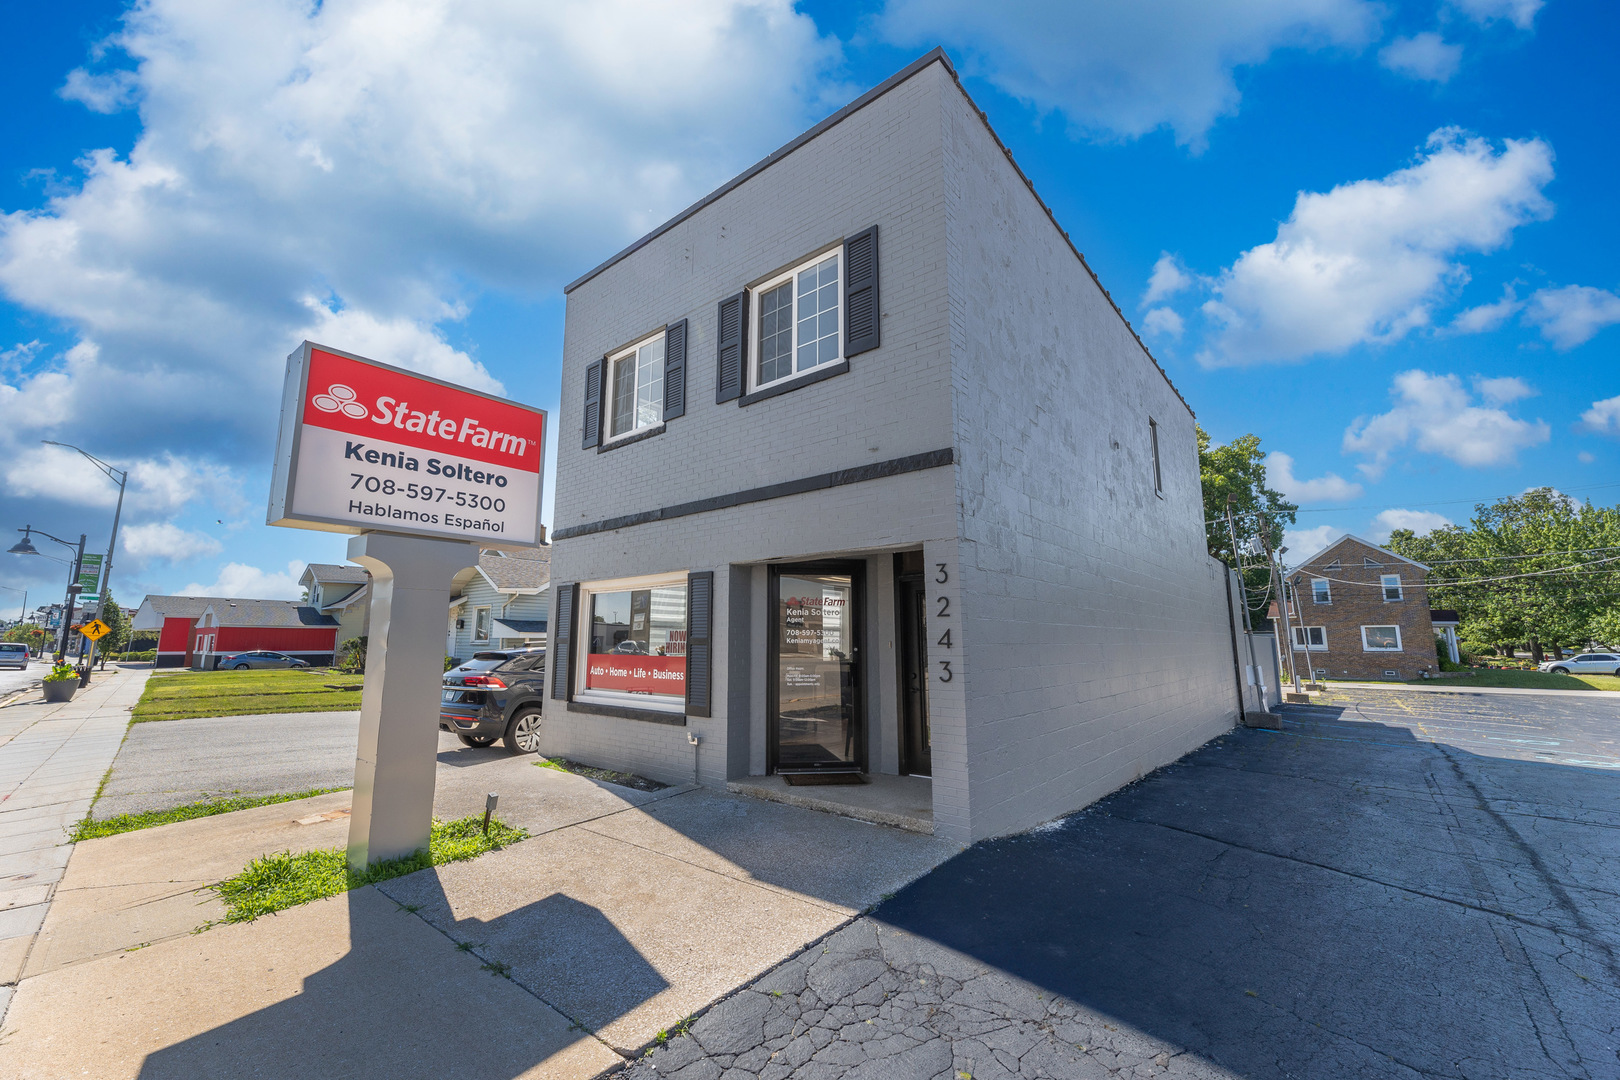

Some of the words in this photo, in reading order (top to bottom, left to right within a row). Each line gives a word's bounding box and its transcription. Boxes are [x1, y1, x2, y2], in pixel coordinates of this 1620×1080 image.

[344, 441, 419, 472] Kenia
[426, 458, 508, 488] Soltero
[350, 473, 506, 513] 708-597-5300
[348, 500, 439, 524] Hablamos
[444, 513, 505, 533] Español
[786, 608, 809, 616] Kenia
[811, 608, 840, 616] Sotero
[669, 630, 687, 642] NOW
[665, 642, 686, 654] HIRIN
[590, 666, 604, 675] Auto
[609, 667, 628, 677] Home
[633, 668, 646, 678] Life
[653, 669, 684, 680] Business
